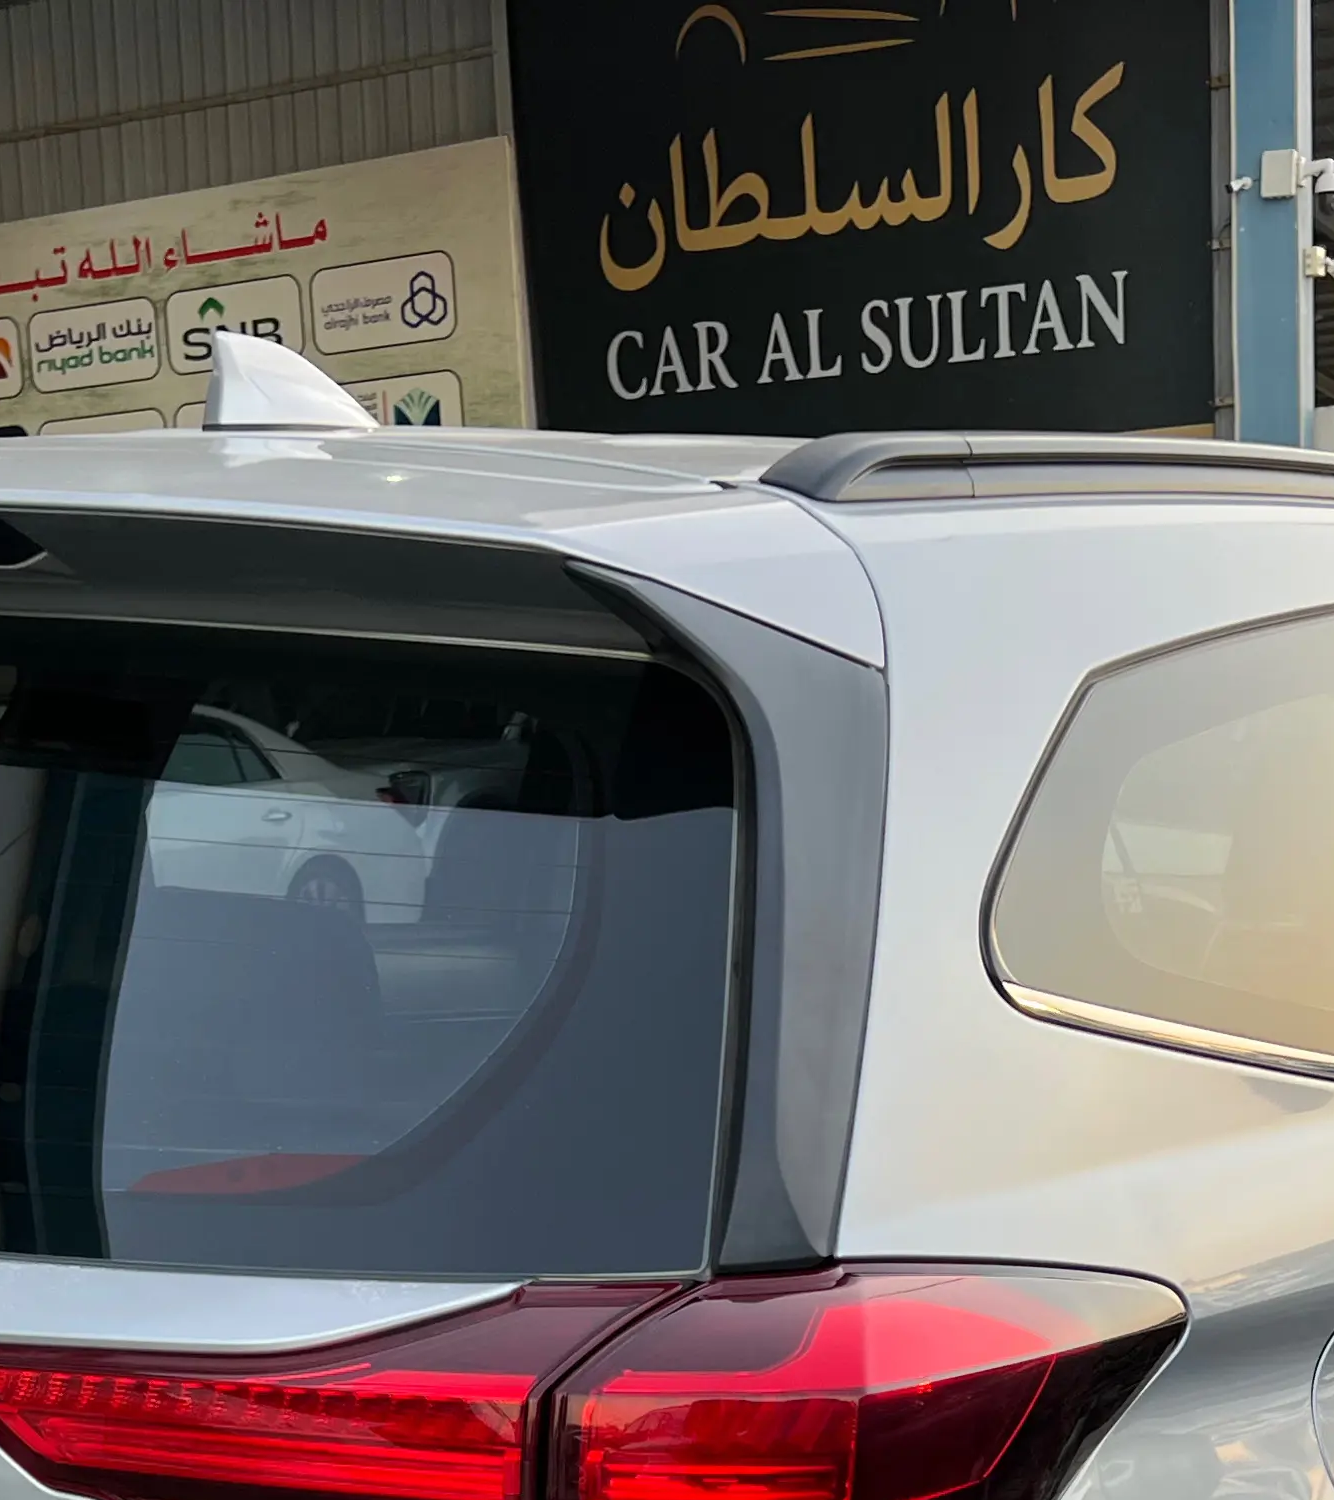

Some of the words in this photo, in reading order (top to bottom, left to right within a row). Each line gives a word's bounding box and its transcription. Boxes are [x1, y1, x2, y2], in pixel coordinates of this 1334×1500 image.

[78, 235, 152, 280] الله
[163, 211, 328, 272] ماشاء
[34, 322, 107, 353] الرياض
[112, 318, 153, 338] بنك
[606, 319, 739, 401] CAR
[757, 308, 842, 384] AL
[859, 270, 1129, 374] SULTAN
[36, 346, 94, 376] riyad
[99, 340, 155, 364] bank
